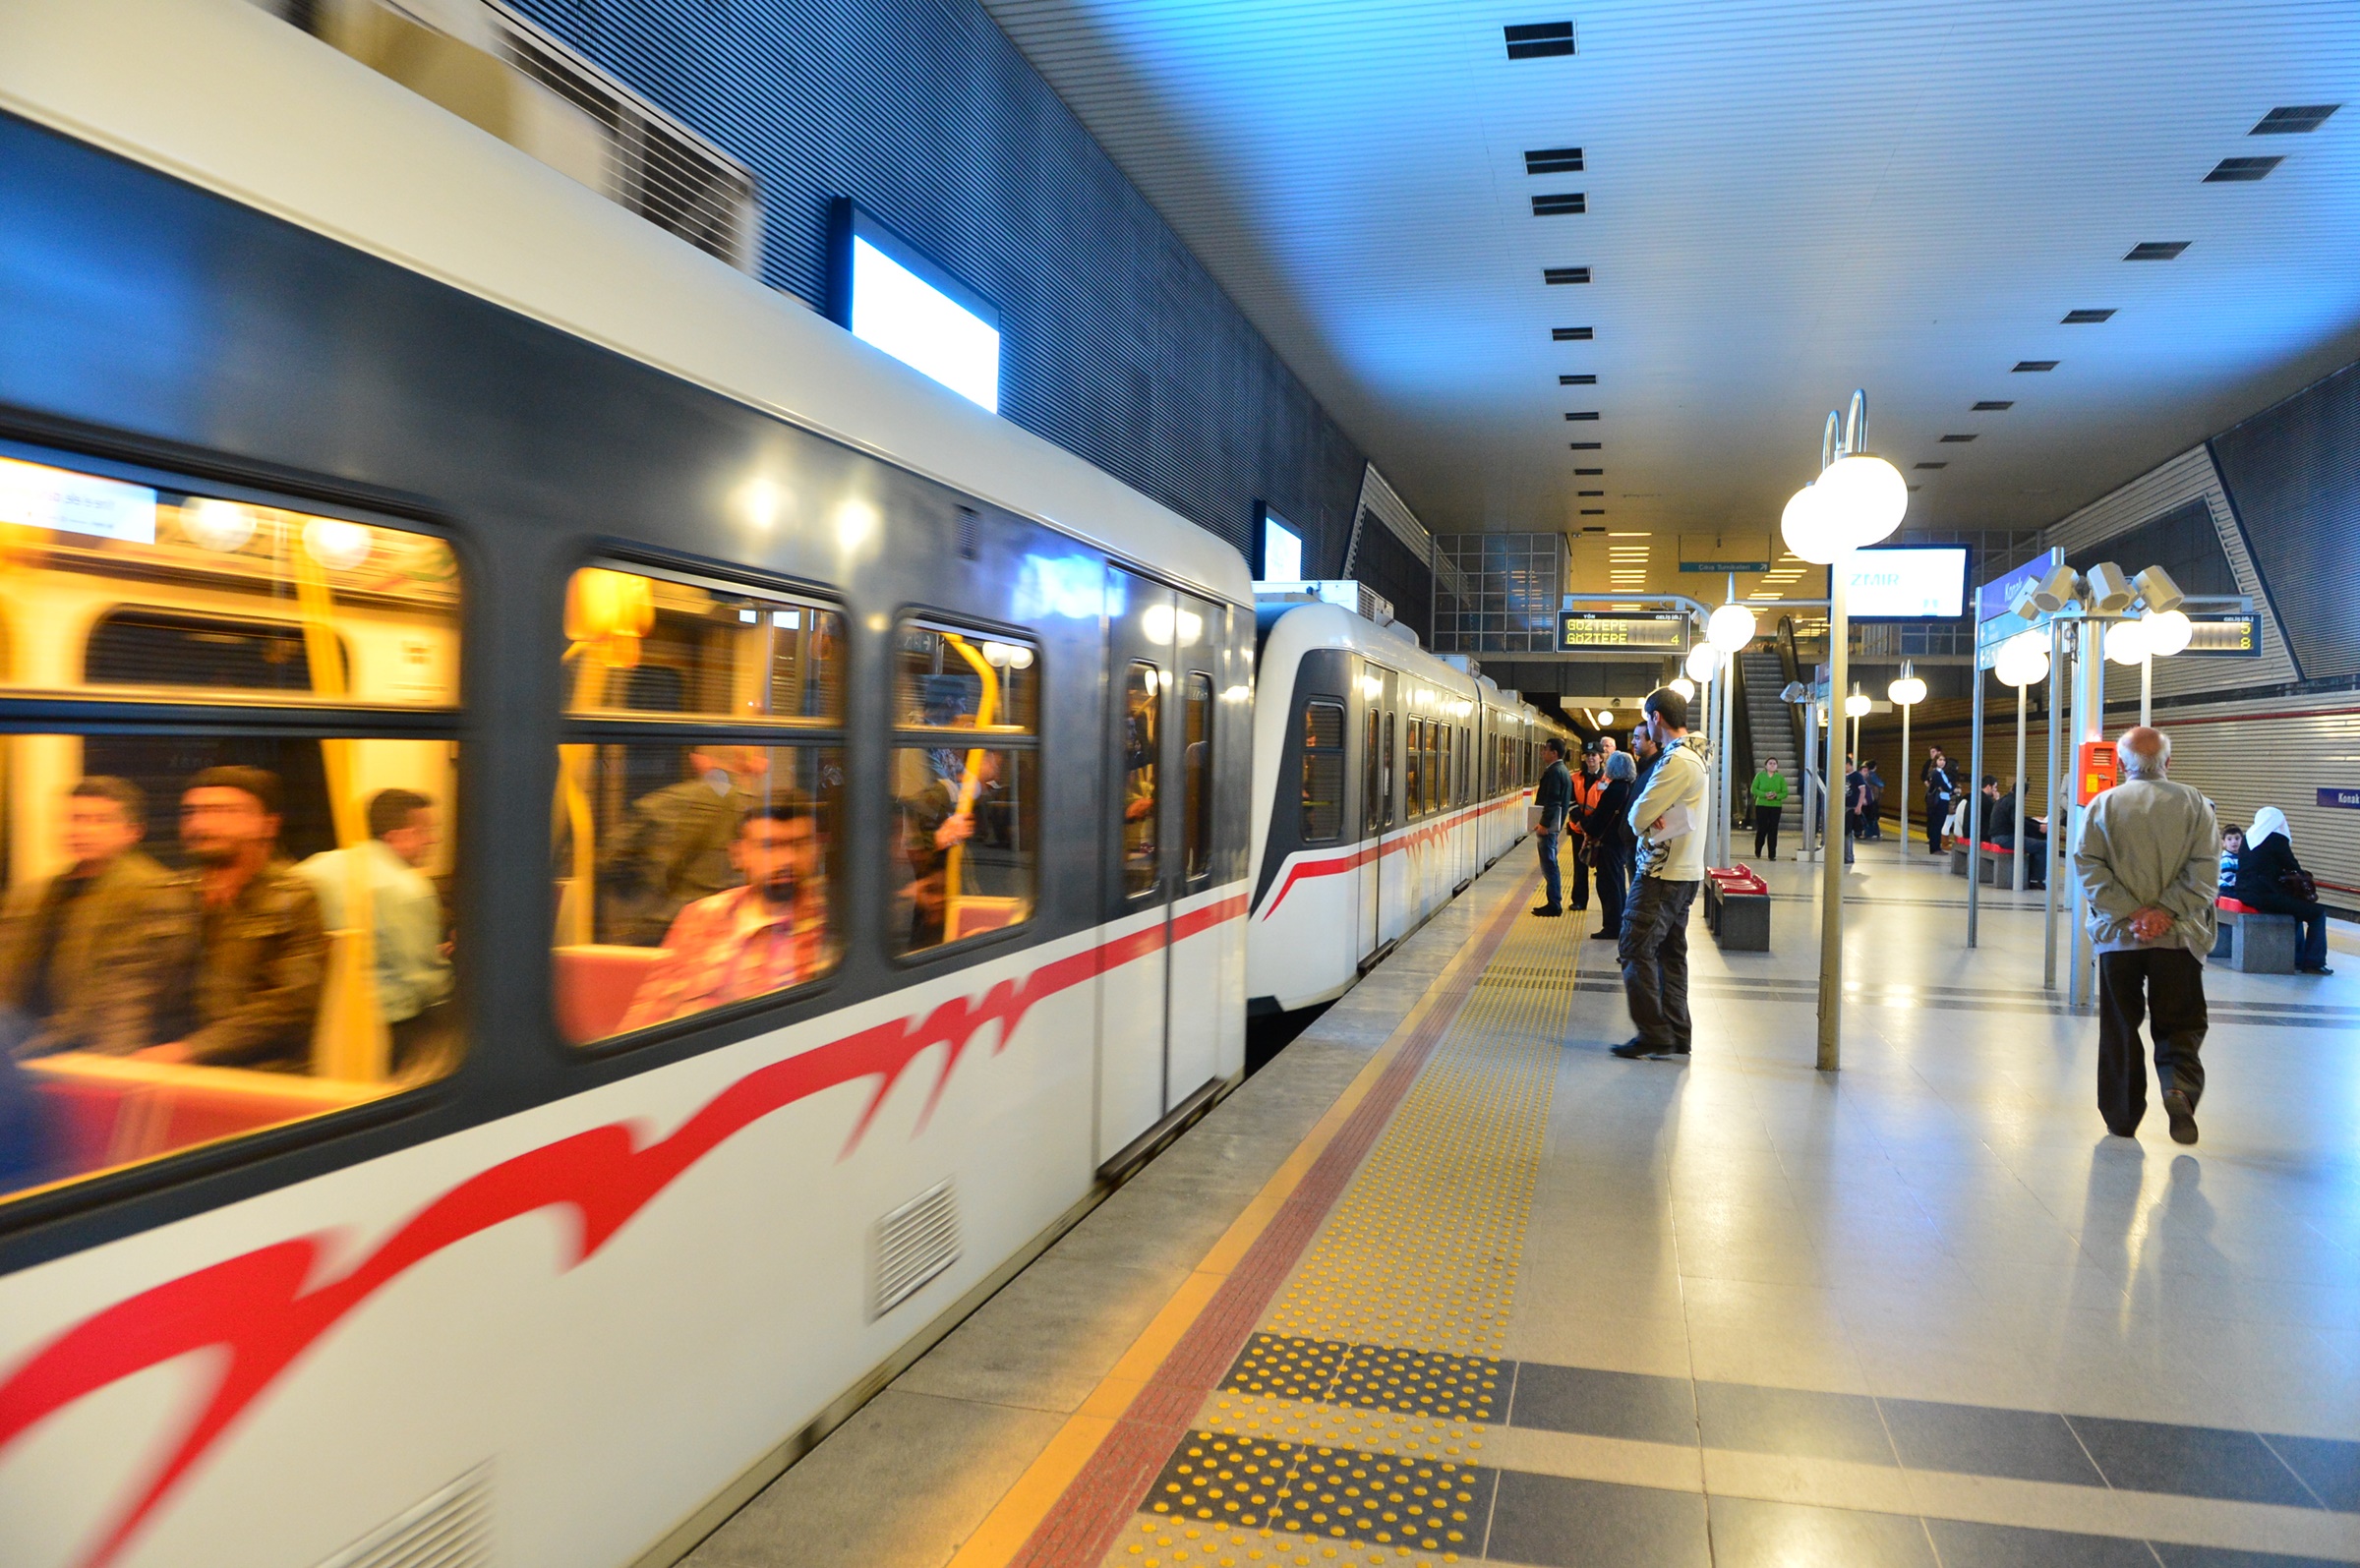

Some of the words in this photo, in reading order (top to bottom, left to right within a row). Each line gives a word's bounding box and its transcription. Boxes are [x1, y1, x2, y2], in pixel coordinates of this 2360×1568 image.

[2240, 622, 2251, 635] 5
[1566, 633, 1627, 645] GÖZTEPE
[1671, 634, 1680, 645] 4
[2240, 637, 2251, 650] 8
[2337, 792, 2360, 804] Konak
